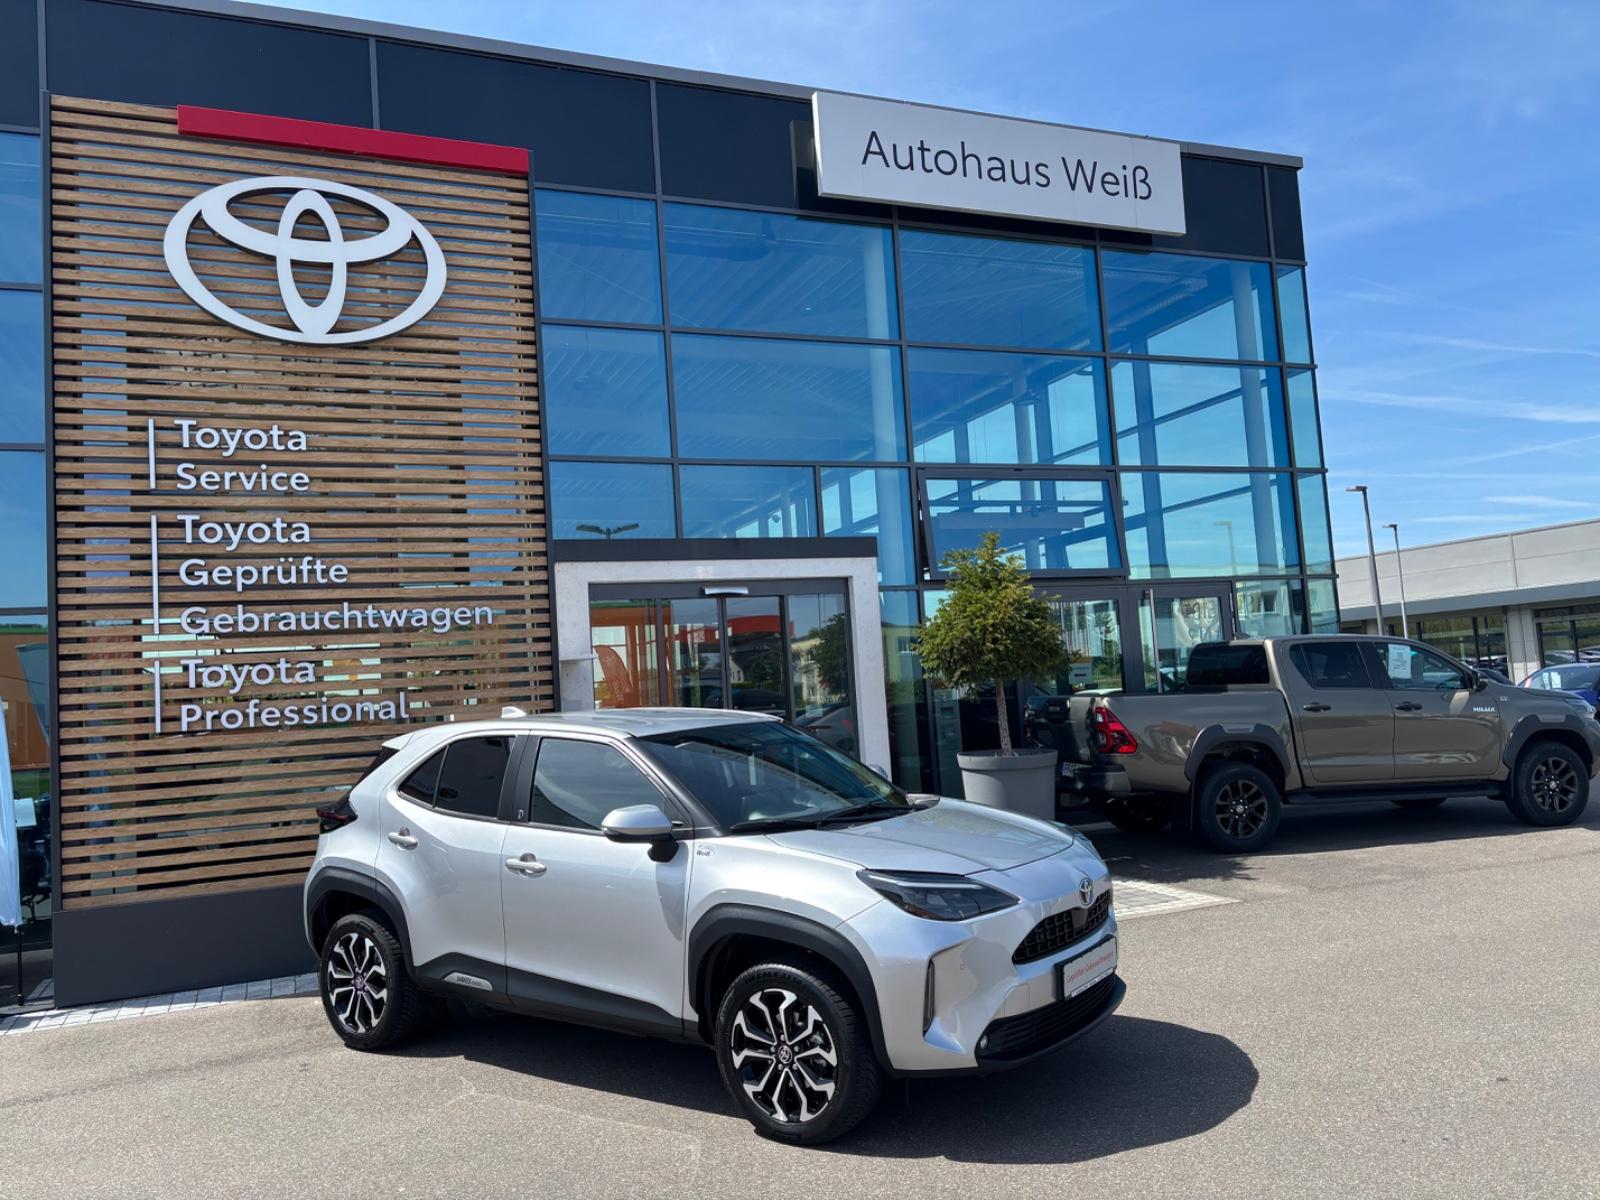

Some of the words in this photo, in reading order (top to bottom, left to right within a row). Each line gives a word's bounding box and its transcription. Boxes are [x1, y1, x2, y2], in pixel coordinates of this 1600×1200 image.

[861, 130, 1051, 188] Autohaus
[1061, 156, 1153, 201] Weiß
[174, 420, 307, 457] Toyota
[176, 463, 310, 491] Service
[177, 514, 311, 551] Toyota
[179, 556, 349, 592] Geprüfte
[180, 602, 493, 634] Gebrauchtwagen
[180, 658, 316, 694] Toyota
[181, 692, 409, 732] Professional
